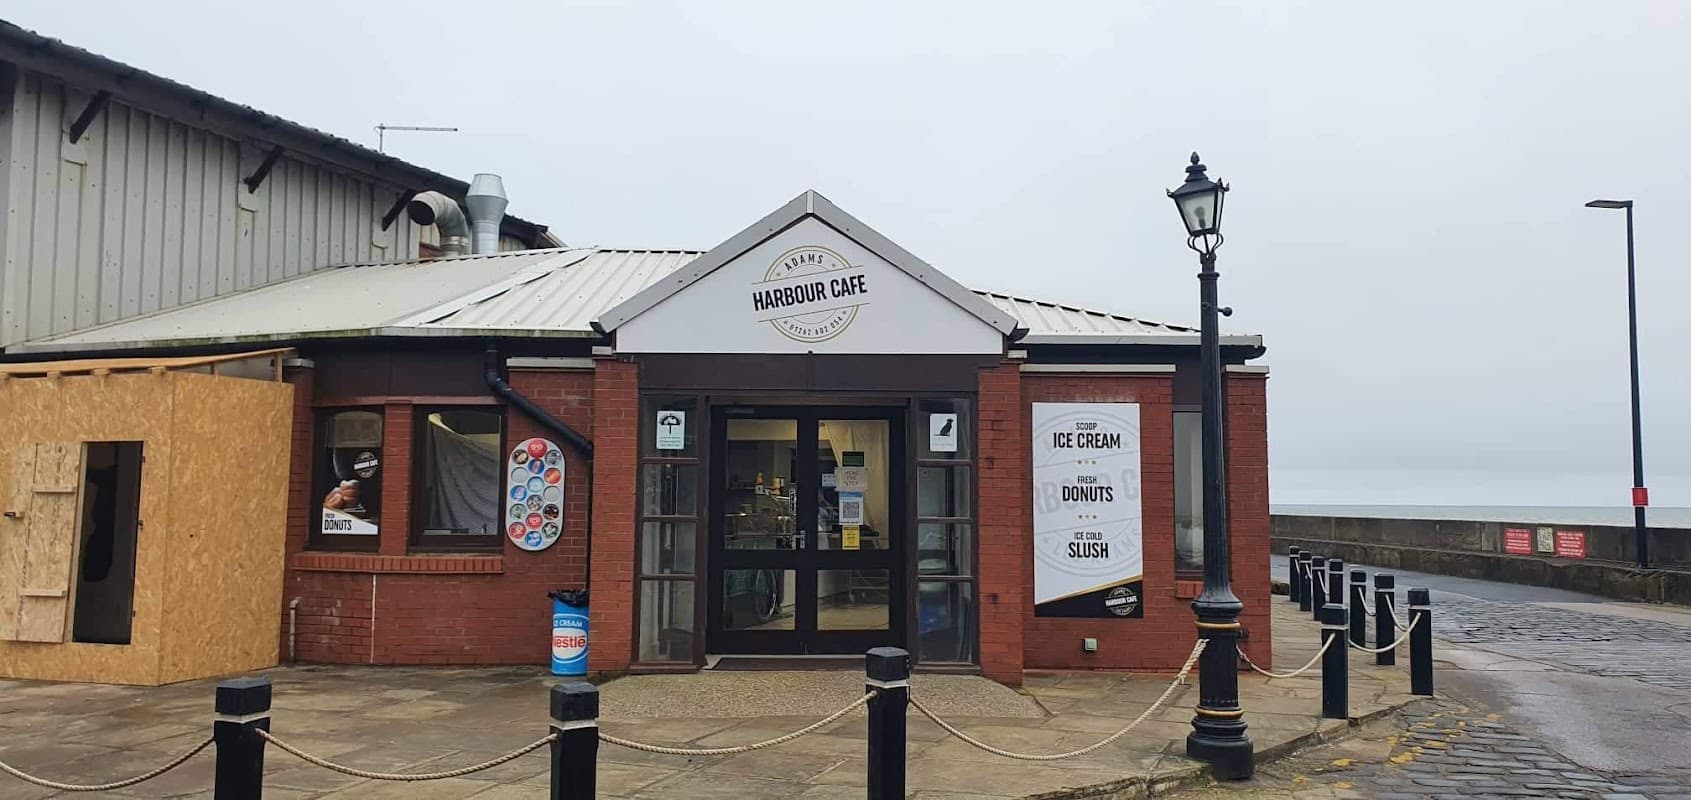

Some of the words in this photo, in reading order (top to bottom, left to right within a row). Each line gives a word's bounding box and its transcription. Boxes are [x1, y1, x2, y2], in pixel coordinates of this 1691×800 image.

[784, 253, 824, 271] ADAMS
[753, 282, 828, 311] HARBOUR
[830, 274, 868, 299] CAFE
[1075, 422, 1098, 431] SCOOP
[1053, 432, 1074, 449] ICE
[1077, 432, 1121, 449] CREAM
[1077, 475, 1098, 485] FRESH
[1062, 486, 1114, 502] DONUTS
[324, 519, 352, 531] DONUTS
[1073, 531, 1084, 541] ICE
[1086, 531, 1103, 541] COLD
[1068, 541, 1109, 559] SLUSH
